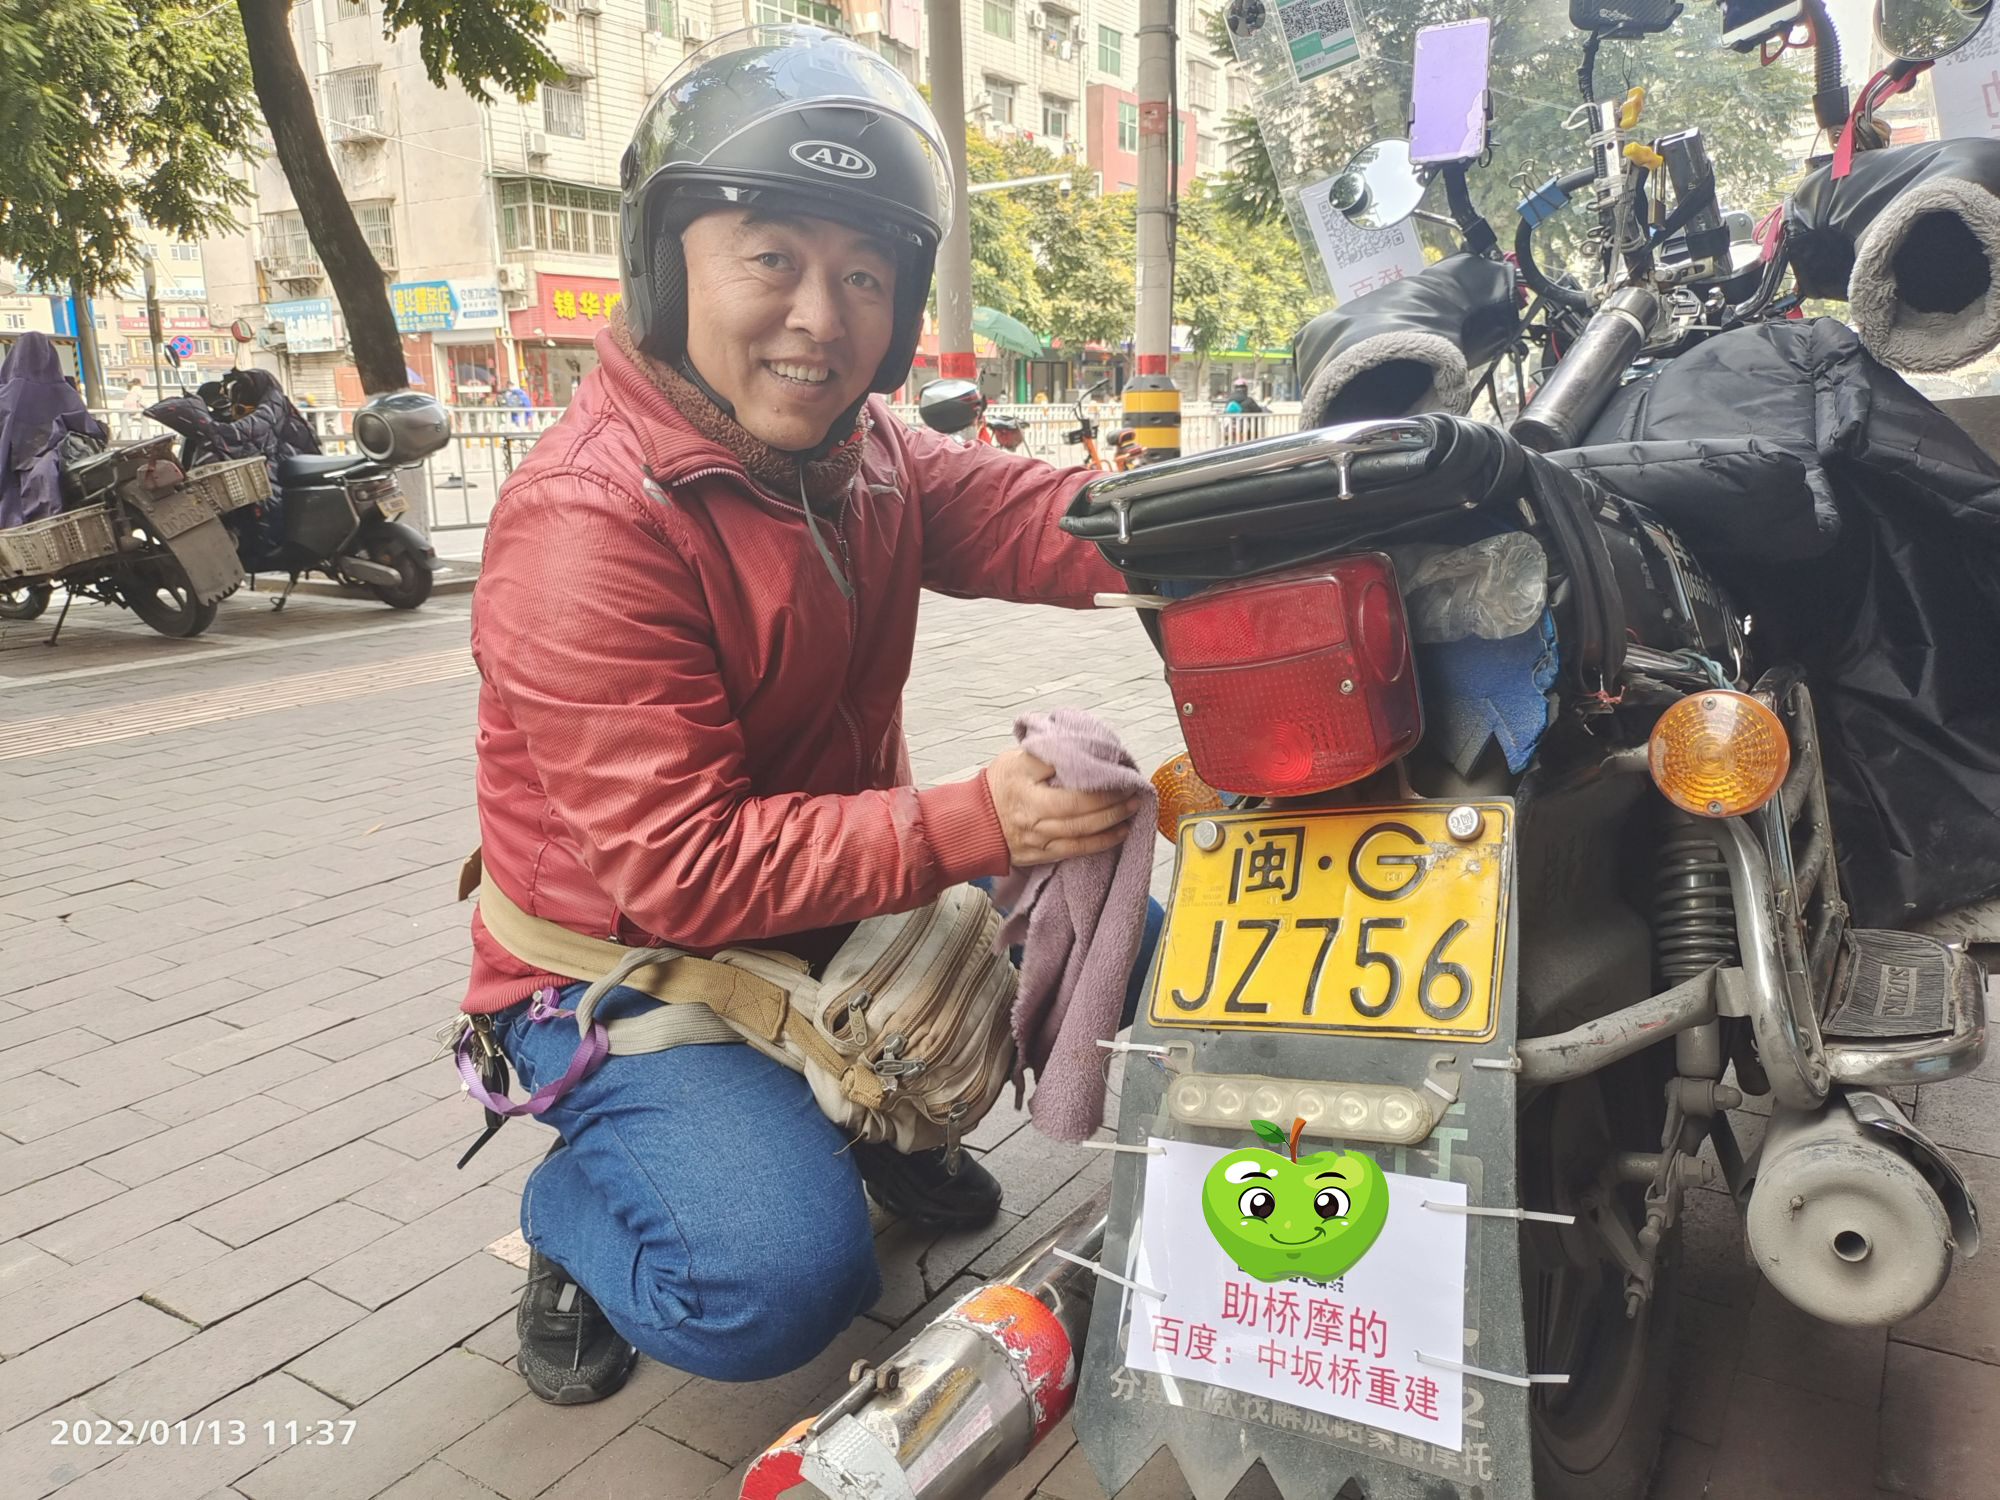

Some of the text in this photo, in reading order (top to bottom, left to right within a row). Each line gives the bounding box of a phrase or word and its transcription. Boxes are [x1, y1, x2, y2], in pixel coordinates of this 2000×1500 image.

[806, 147, 864, 171] AD
[1171, 918, 1474, 1021] JZ756
[1882, 966, 1911, 1017] SUZUKI
[1221, 1280, 1389, 1361] 助桥摩的
